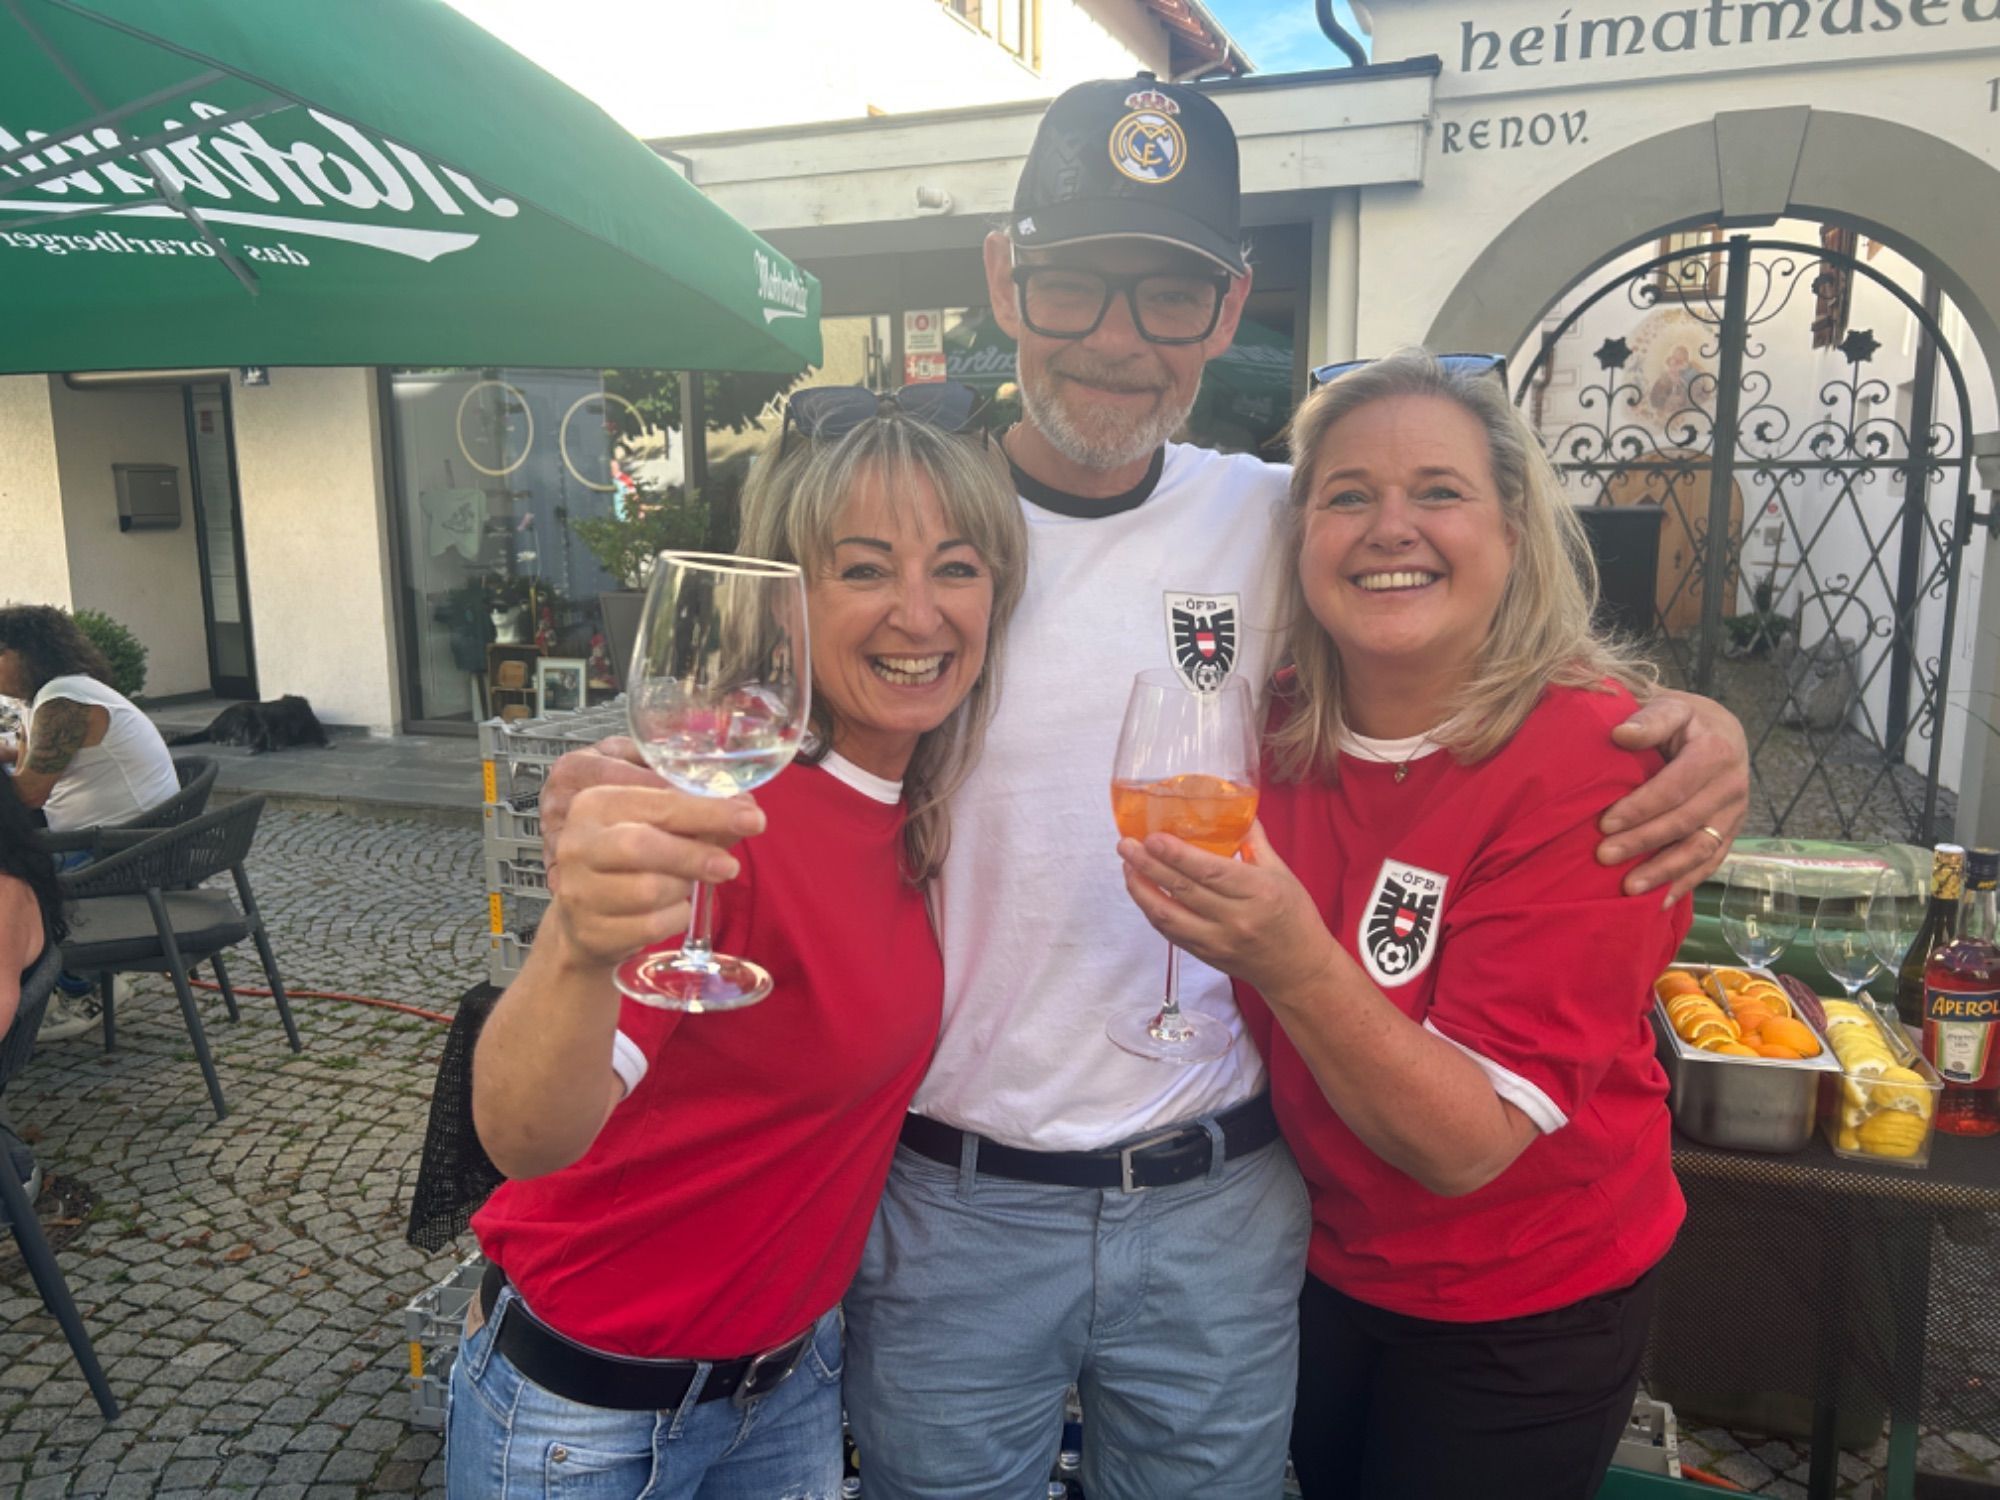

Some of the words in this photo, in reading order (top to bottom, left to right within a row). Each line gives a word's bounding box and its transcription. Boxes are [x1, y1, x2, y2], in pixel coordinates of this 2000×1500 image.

[1441, 108, 1589, 154] RENOV.
[1186, 598, 1217, 610] ÖFB
[1402, 871, 1435, 890] ÖFB
[1932, 995, 2000, 1017] APEROL
